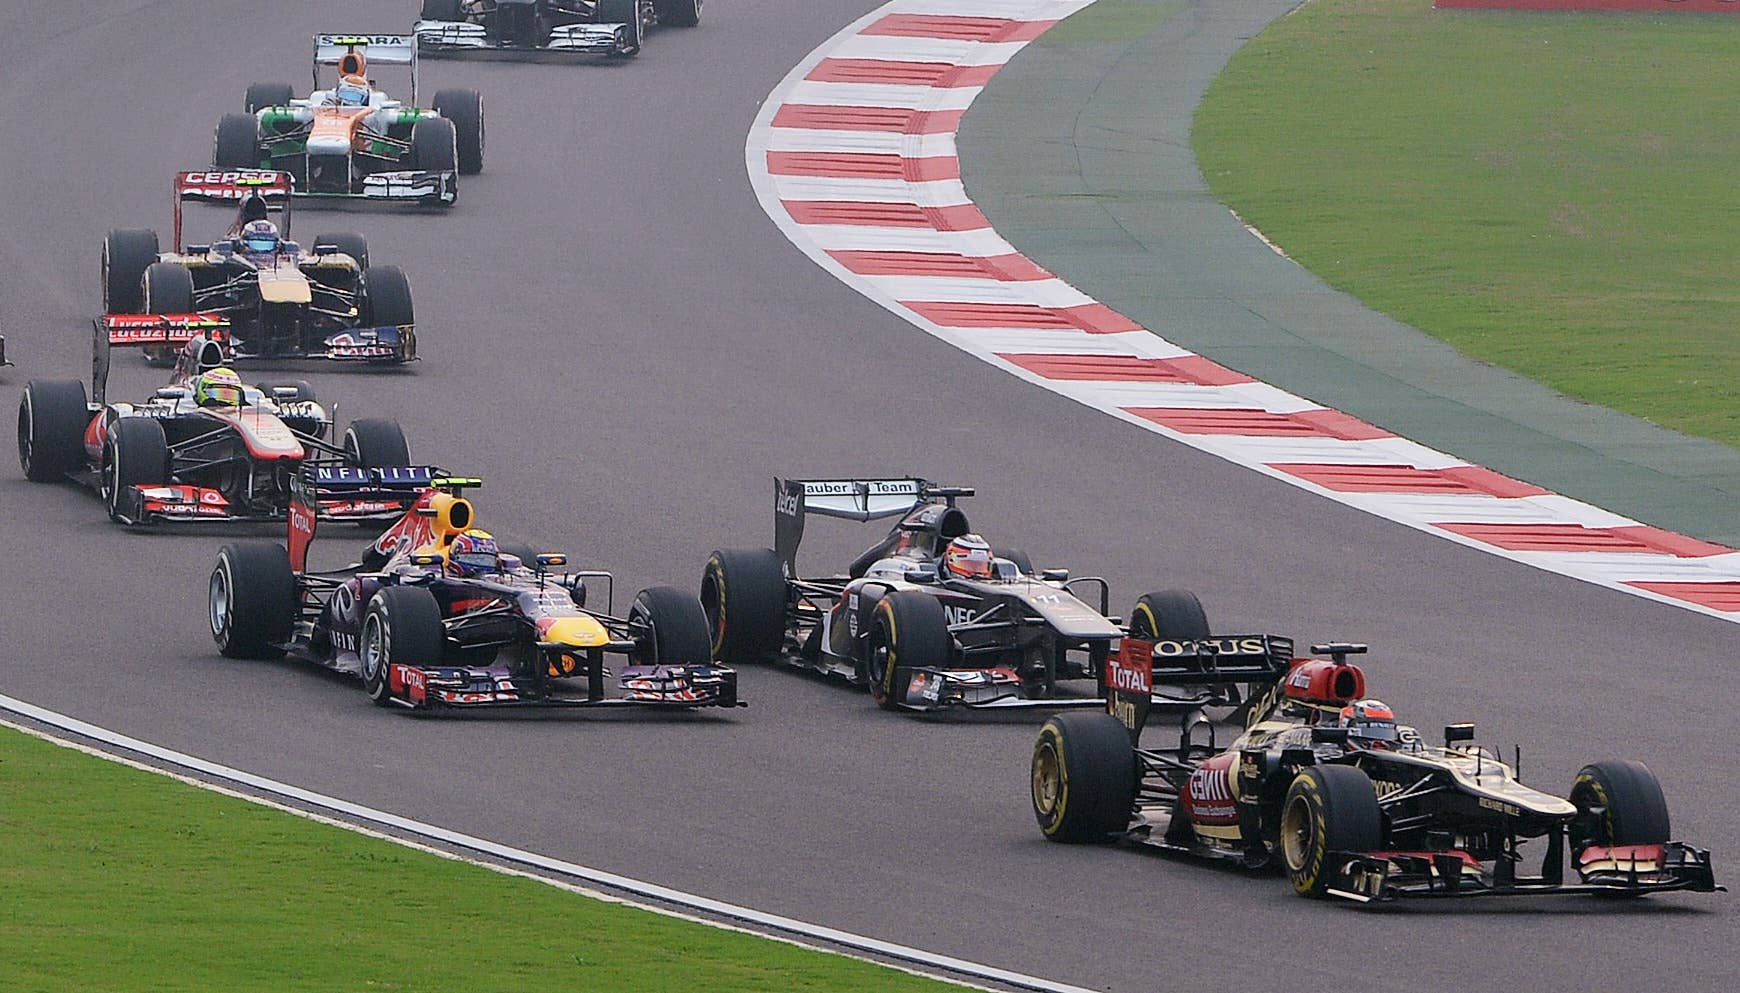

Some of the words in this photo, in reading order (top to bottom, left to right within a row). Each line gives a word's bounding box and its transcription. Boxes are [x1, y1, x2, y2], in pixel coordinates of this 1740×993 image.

[873, 482, 912, 493] Team
[289, 506, 311, 534] TOTAL
[1152, 640, 1265, 656] OTUS
[397, 666, 425, 690] TOTAL
[1109, 660, 1149, 692] TOTAL
